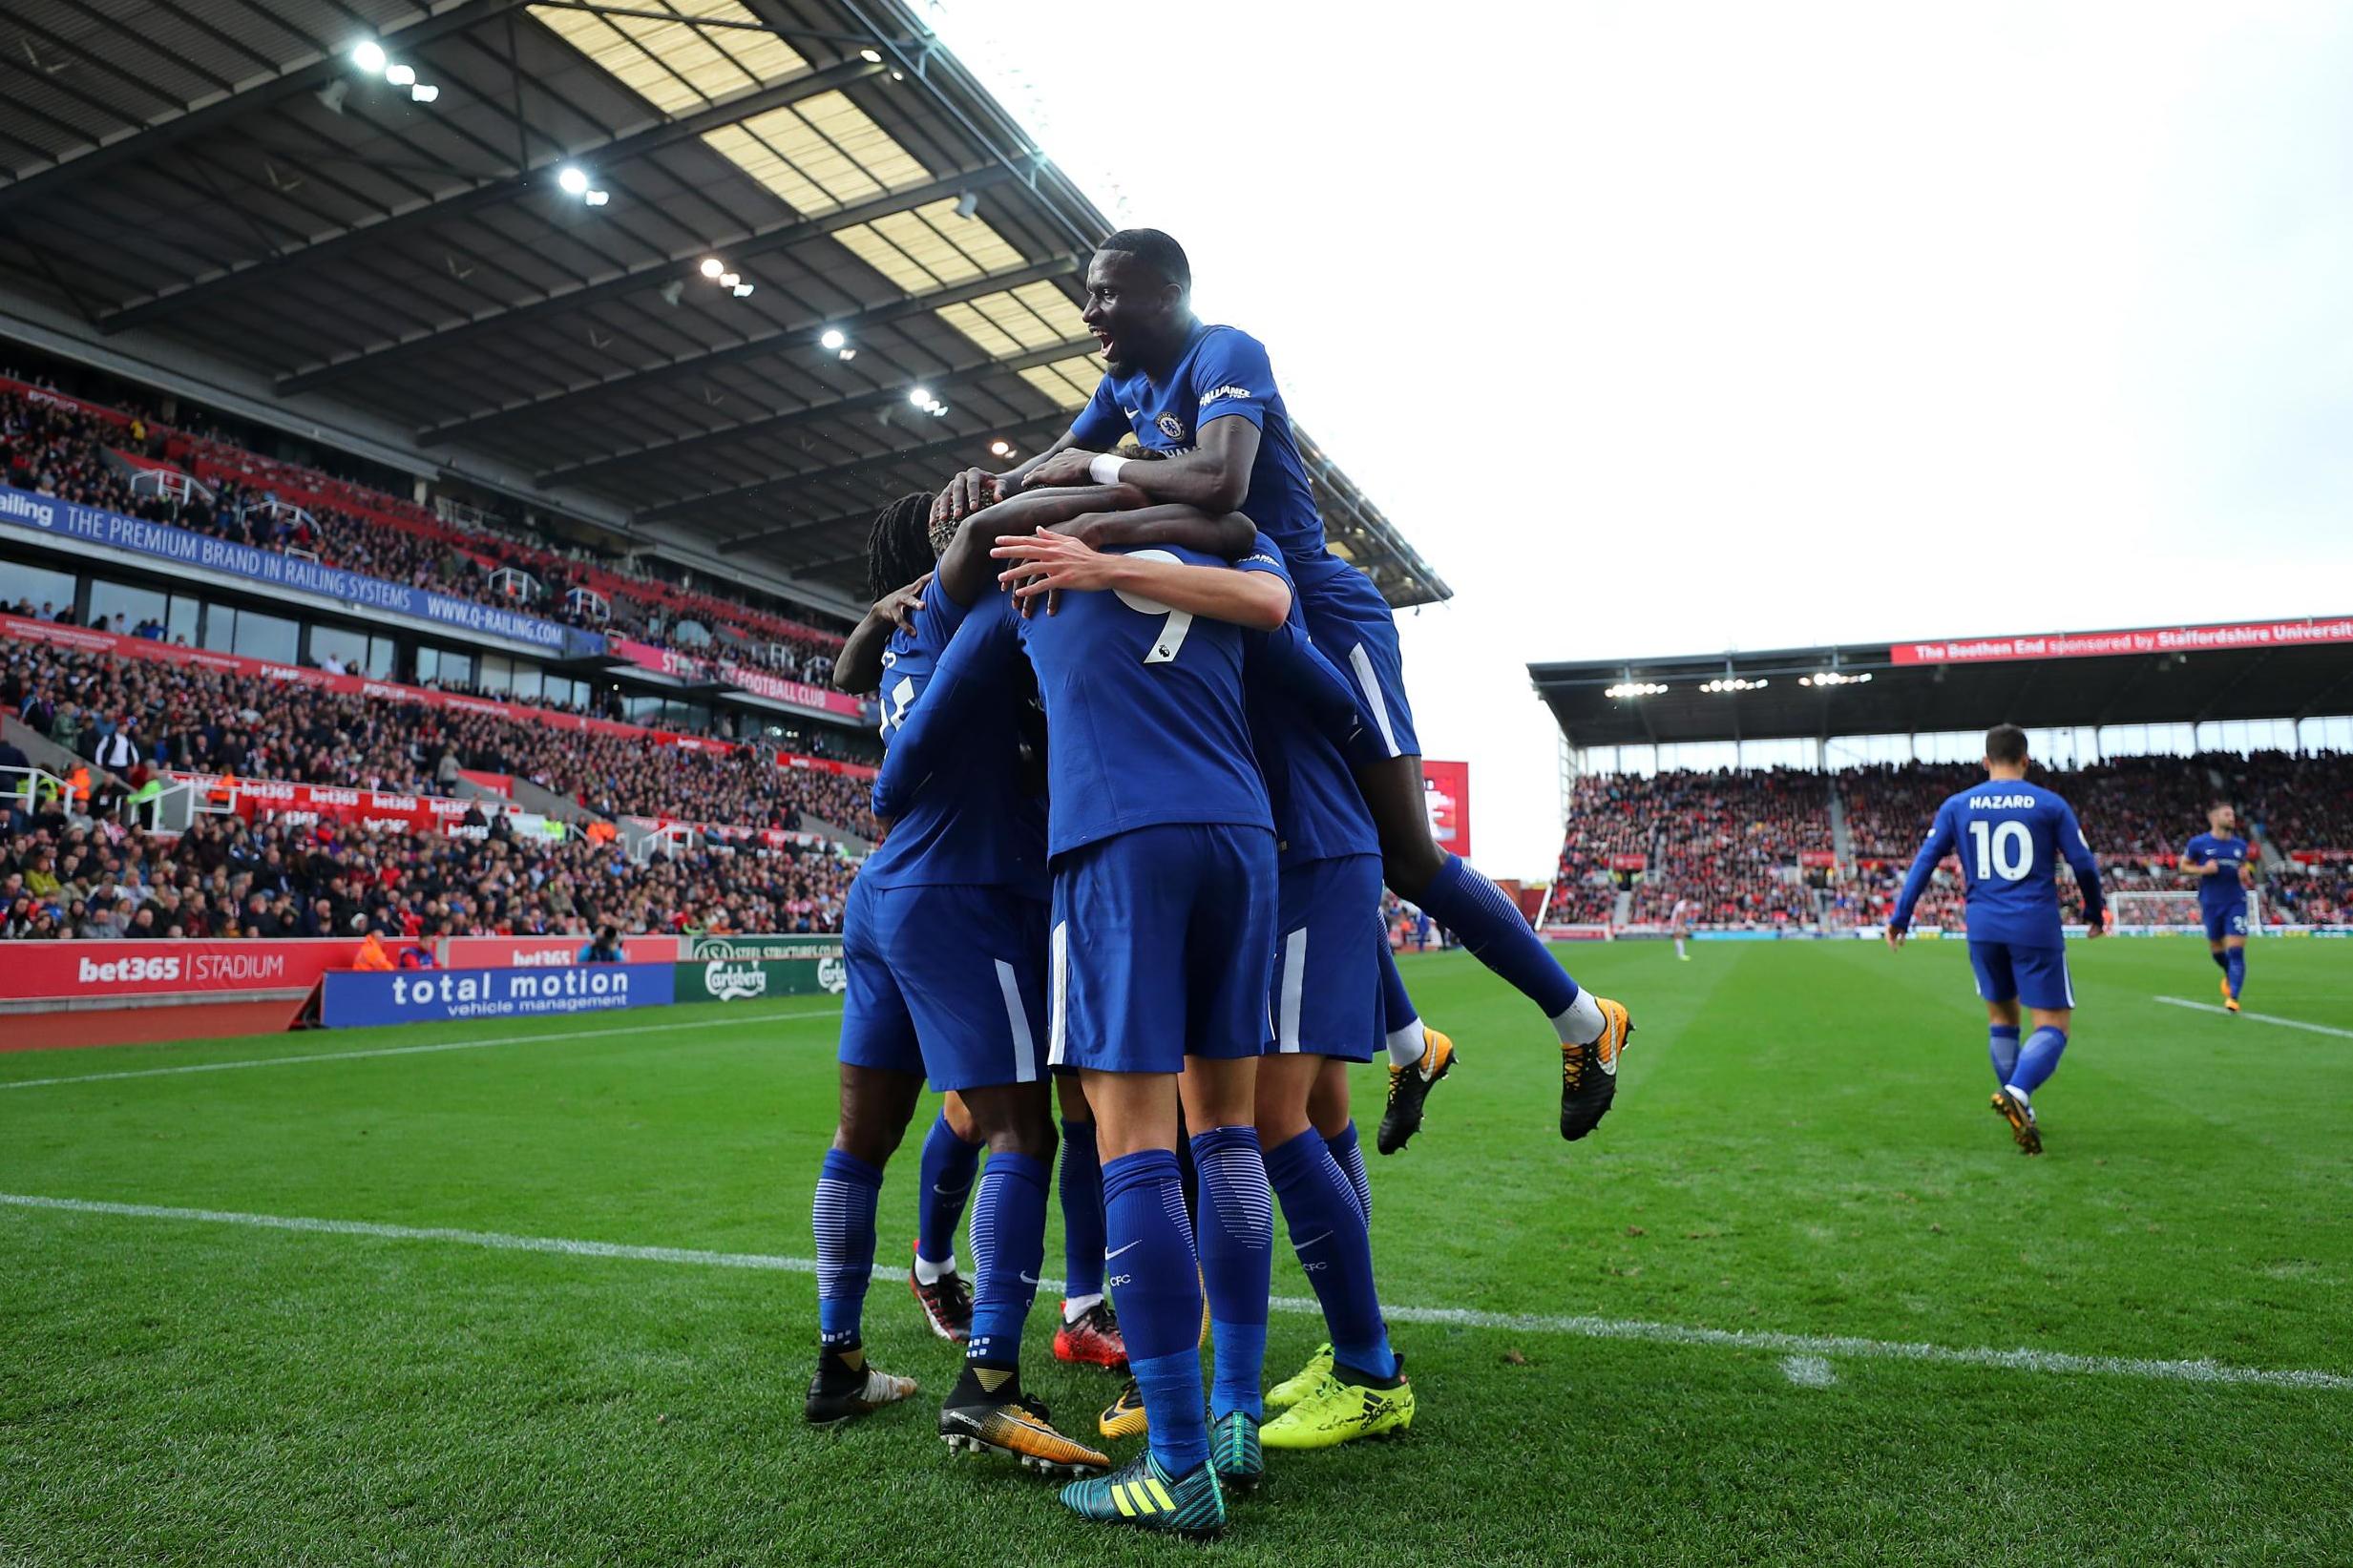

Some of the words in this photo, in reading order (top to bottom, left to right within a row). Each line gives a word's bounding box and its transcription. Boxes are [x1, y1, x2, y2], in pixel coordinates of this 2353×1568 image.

[67, 506, 104, 539] THE
[109, 517, 197, 559] PREMIUM
[202, 540, 260, 574] BRAND
[264, 555, 281, 580] IN
[284, 562, 345, 596] RAILING
[348, 575, 411, 611] SYSTEMS
[428, 596, 563, 644] WWW.Q-RAILING.COM
[1915, 645, 1944, 659] The
[2014, 638, 2045, 655] End
[2049, 635, 2131, 656] sponsored
[2133, 634, 2154, 650] by
[2157, 627, 2270, 647] Staffordshire
[738, 670, 797, 701] FOOTBALL
[798, 687, 826, 708] CLUB
[242, 781, 294, 800] bet365
[310, 787, 359, 806] bet365
[372, 793, 417, 810] bet365
[1969, 795, 2035, 809] HAZARD
[1969, 821, 2034, 881] 10
[78, 956, 179, 983] bet365
[196, 954, 284, 980] STADIUM
[705, 961, 767, 1000] Carlsberg
[392, 972, 491, 1004] total
[510, 969, 628, 997] motion
[448, 999, 514, 1016] vehicle
[519, 994, 627, 1014] management
[1109, 1274, 1131, 1287] CFC
[1302, 1262, 1328, 1273] CFC
[1360, 1398, 1394, 1430] adidas
